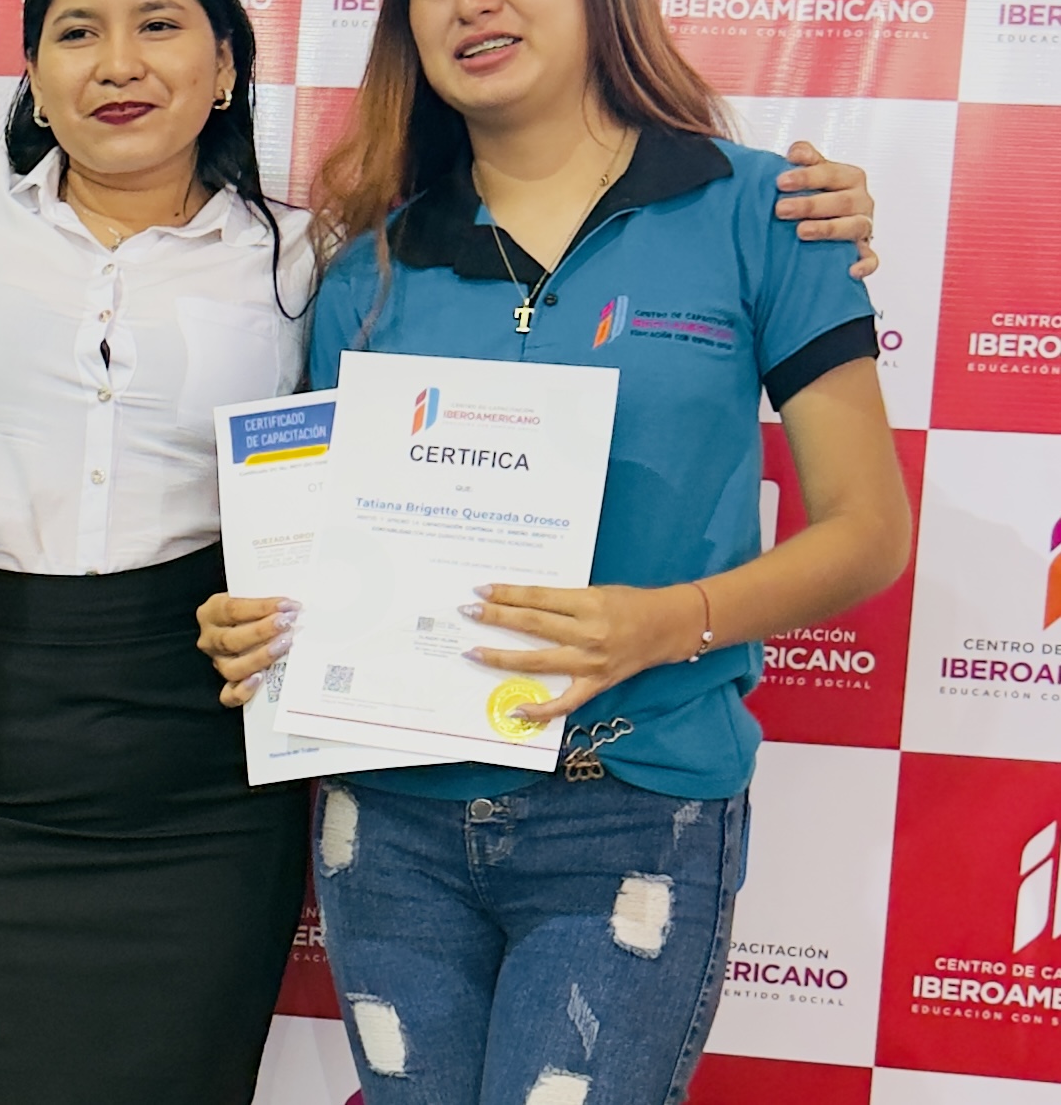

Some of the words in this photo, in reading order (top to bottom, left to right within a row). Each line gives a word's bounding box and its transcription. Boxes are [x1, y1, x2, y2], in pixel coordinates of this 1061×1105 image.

[991, 313, 1061, 328] CENTRO
[245, 412, 305, 432] CERTIFICADO
[443, 410, 540, 425] IBEROAMERICANO
[246, 435, 259, 448] DE
[261, 424, 327, 446] CAPACITACIÓN
[410, 444, 529, 471] CERTIFICA
[355, 498, 401, 511] Tatiana
[406, 502, 458, 517] Brigette
[463, 508, 519, 522] Quezada
[523, 514, 570, 528] Orosco
[963, 638, 1035, 654] CENTRO
[1042, 644, 1061, 655] DE
[941, 657, 1061, 685] IBEROA
[815, 678, 871, 690] SOCIAL
[939, 686, 1031, 699] EDUCACIÓN
[935, 957, 1007, 975] CENTRO
[1012, 964, 1035, 978] DE
[789, 994, 843, 1006] SOCIAL
[911, 1004, 1003, 1020] EDUCACIÓN
[1011, 1012, 1043, 1024] CON
